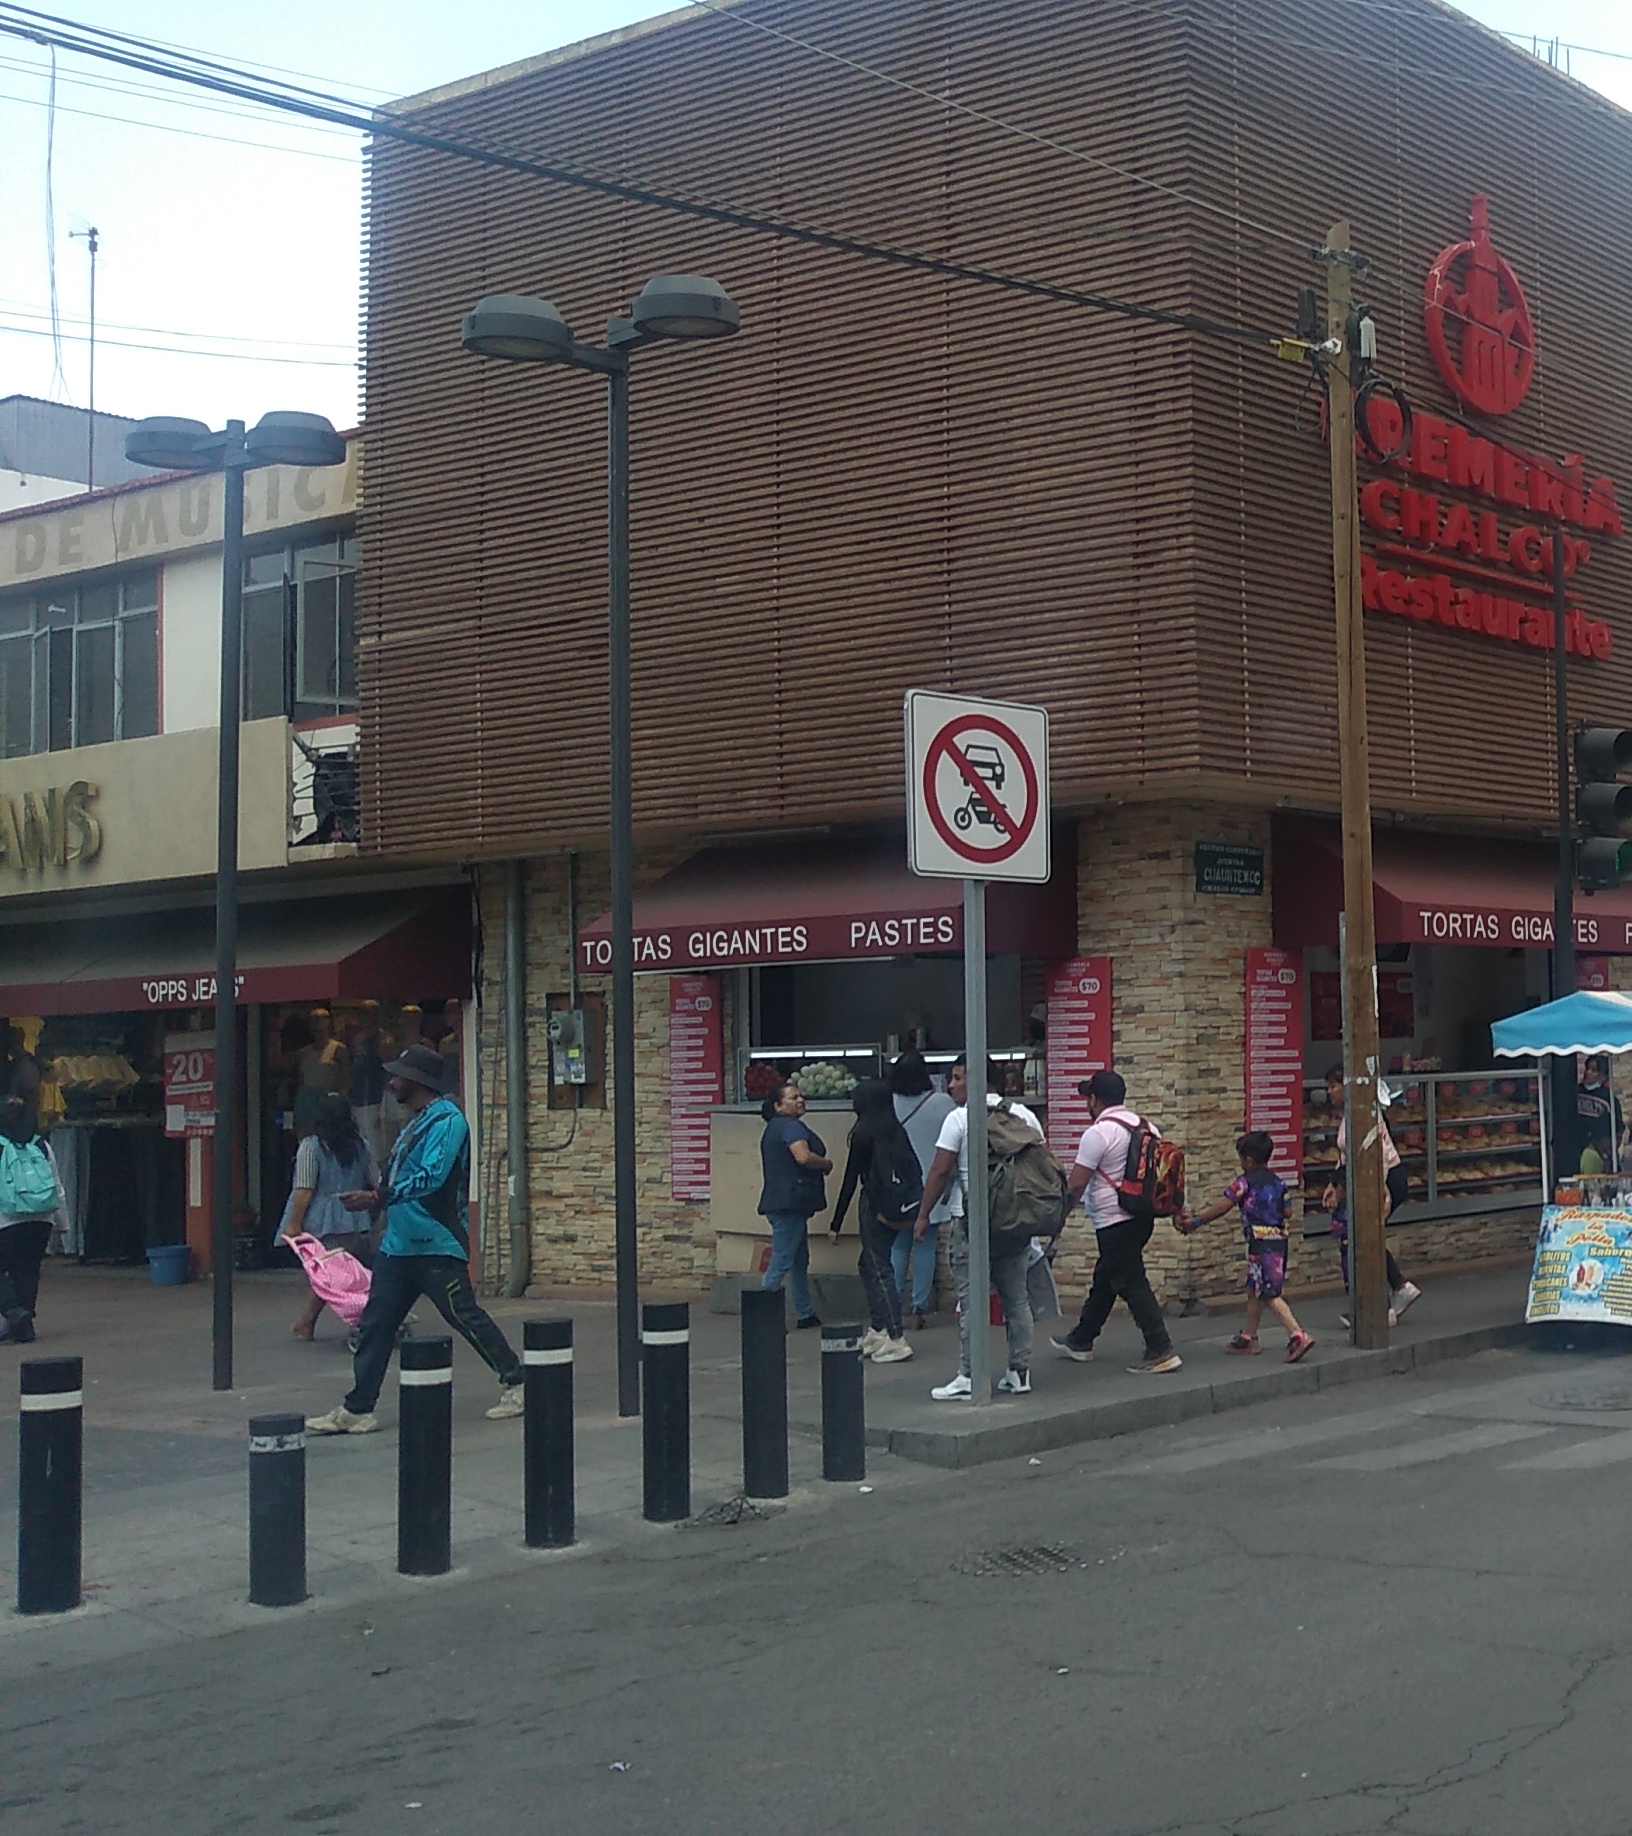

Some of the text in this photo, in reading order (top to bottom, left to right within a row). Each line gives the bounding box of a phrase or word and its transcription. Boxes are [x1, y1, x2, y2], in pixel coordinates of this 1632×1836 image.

[1320, 397, 1624, 537] REMERÍA
[14, 515, 86, 575] DE
[1203, 867, 1261, 886] CUAUHTEMOC
[582, 916, 954, 965] TOTAS GIGANTES PASTES
[1419, 911, 1499, 939] TORTAS
[1511, 915, 1599, 944] GIGAES
[192, 976, 245, 1001] JEA"
[1081, 980, 1098, 992] $70
